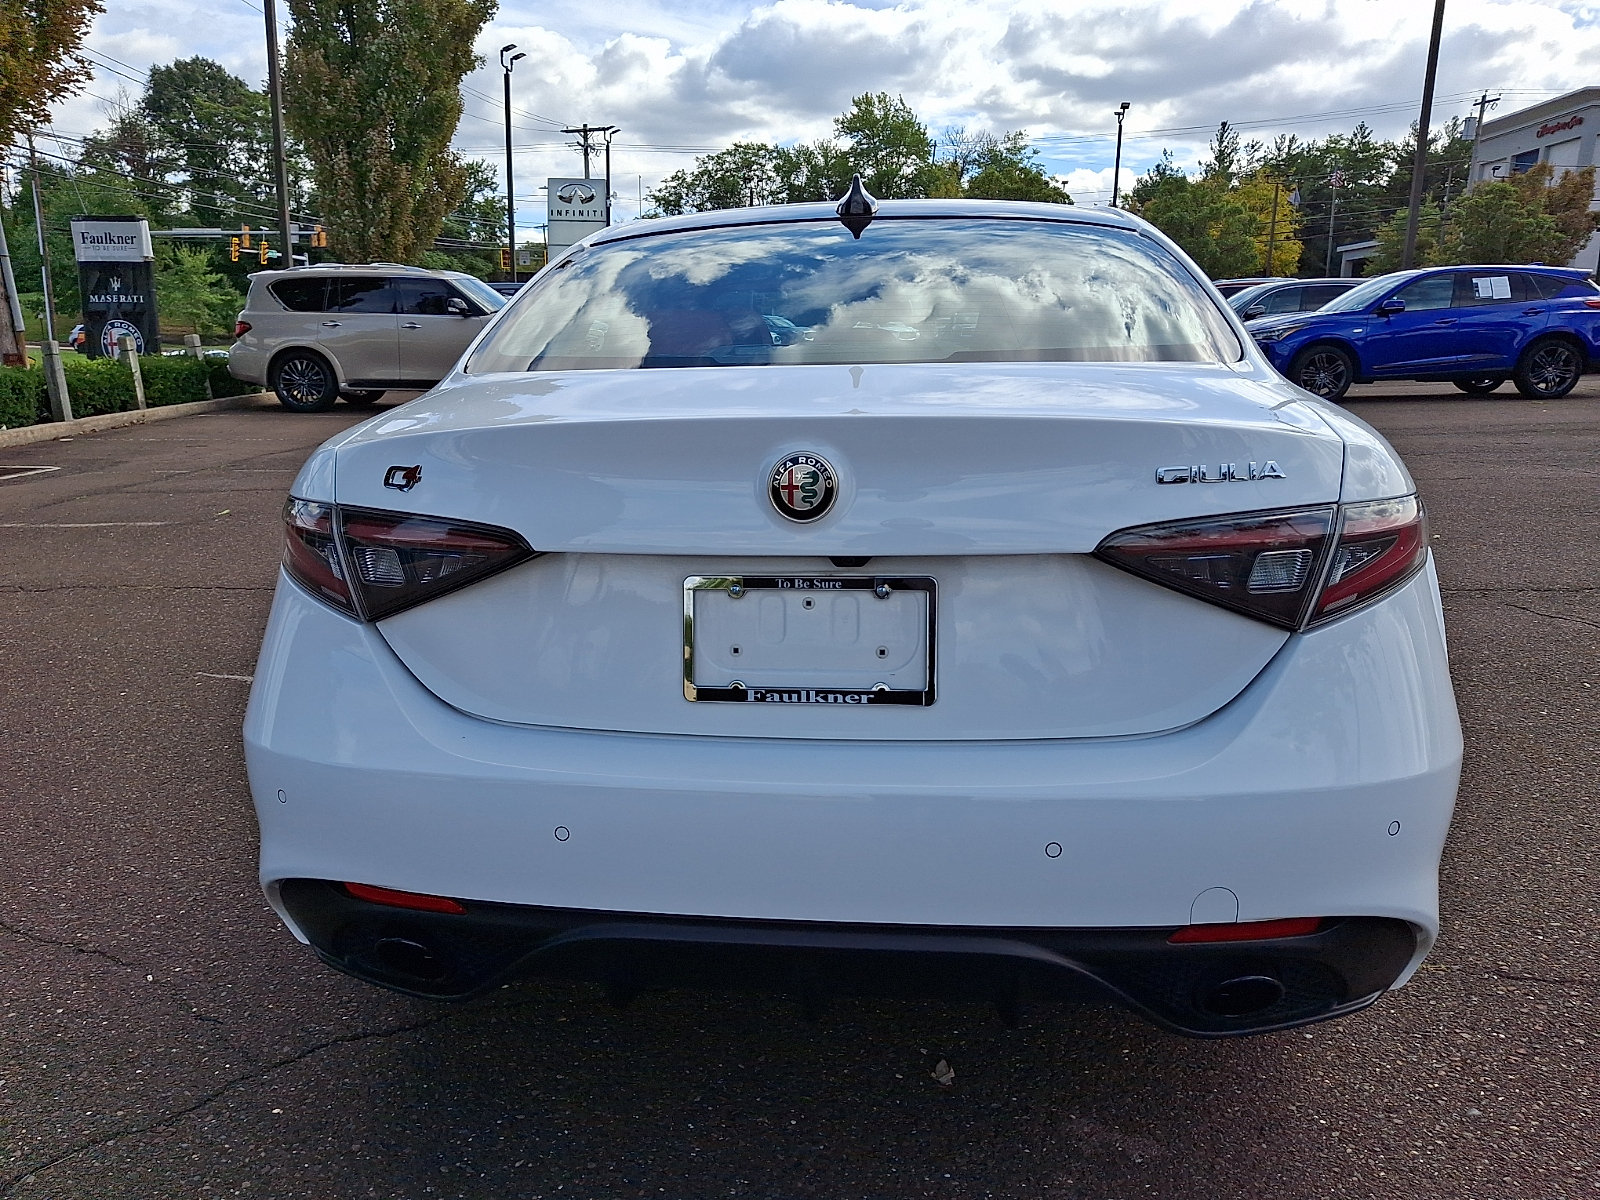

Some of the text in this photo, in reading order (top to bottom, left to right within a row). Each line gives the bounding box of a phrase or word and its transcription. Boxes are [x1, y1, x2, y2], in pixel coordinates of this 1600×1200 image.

[550, 209, 603, 217] INFINITI
[80, 231, 137, 245] Faulkner
[89, 294, 144, 303] MASERATI
[114, 322, 141, 346] ROMEO
[773, 456, 833, 488] ALFA ROMEO
[1155, 460, 1287, 484] GIULIA
[775, 578, 842, 589] To Be Sure
[745, 689, 875, 704] Faulkner
